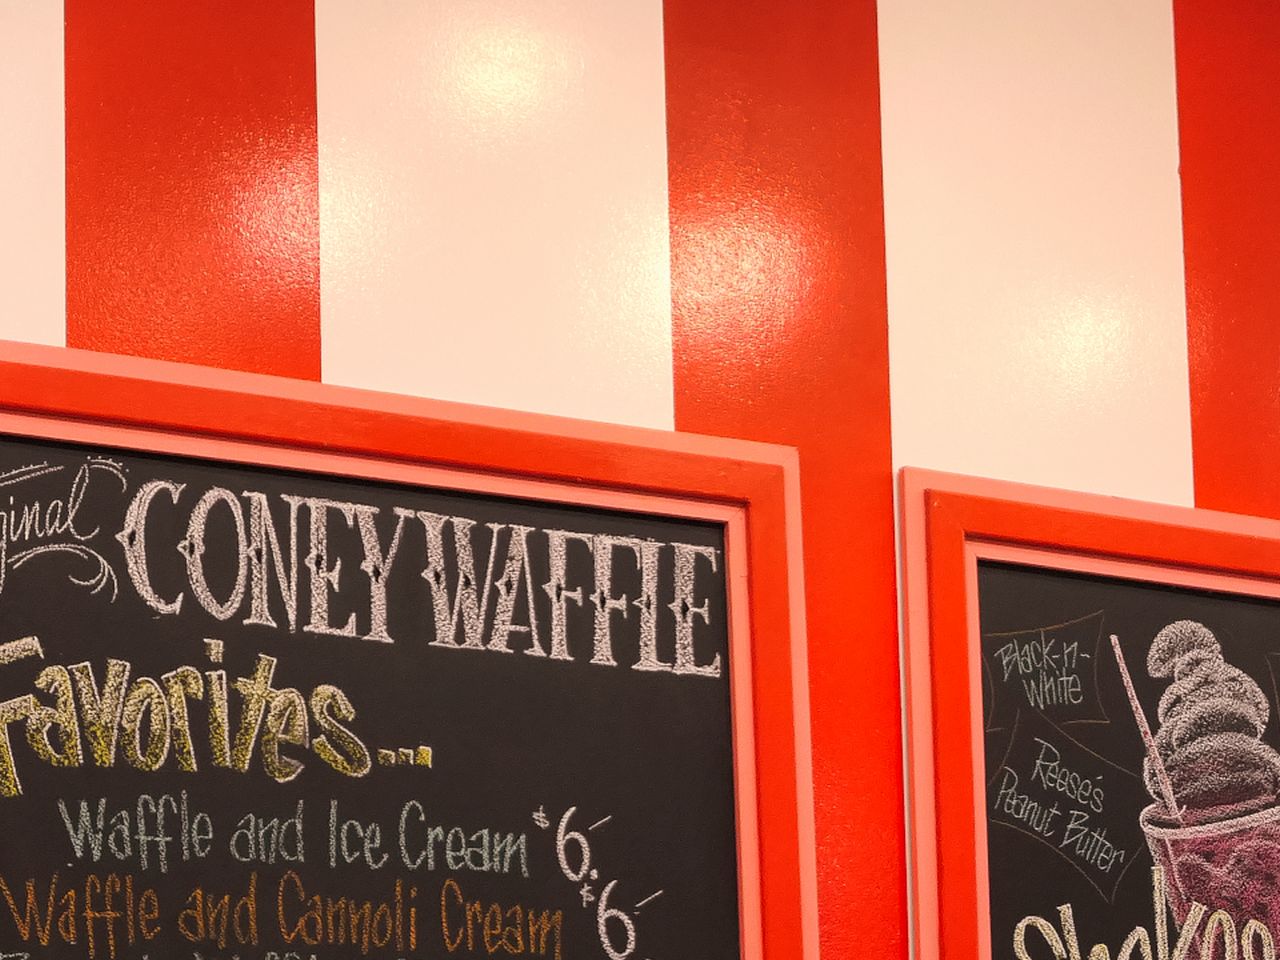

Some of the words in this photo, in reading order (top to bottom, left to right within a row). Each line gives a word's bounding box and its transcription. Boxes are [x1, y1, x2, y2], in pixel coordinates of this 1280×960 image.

[115, 480, 415, 644] CONEY
[417, 510, 721, 678] WAFFLE
[1022, 670, 1084, 710] White
[994, 767, 1062, 837] Peanut
[1059, 811, 1125, 873] Butter
[1031, 738, 1104, 814] Reese's
[58, 790, 213, 874] Waffle
[230, 800, 304, 863] and
[329, 799, 390, 869] Ice
[399, 800, 530, 878] Cream
[0, 871, 160, 960] Waffle
[178, 871, 260, 950] and
[278, 870, 417, 955] Cannoli
